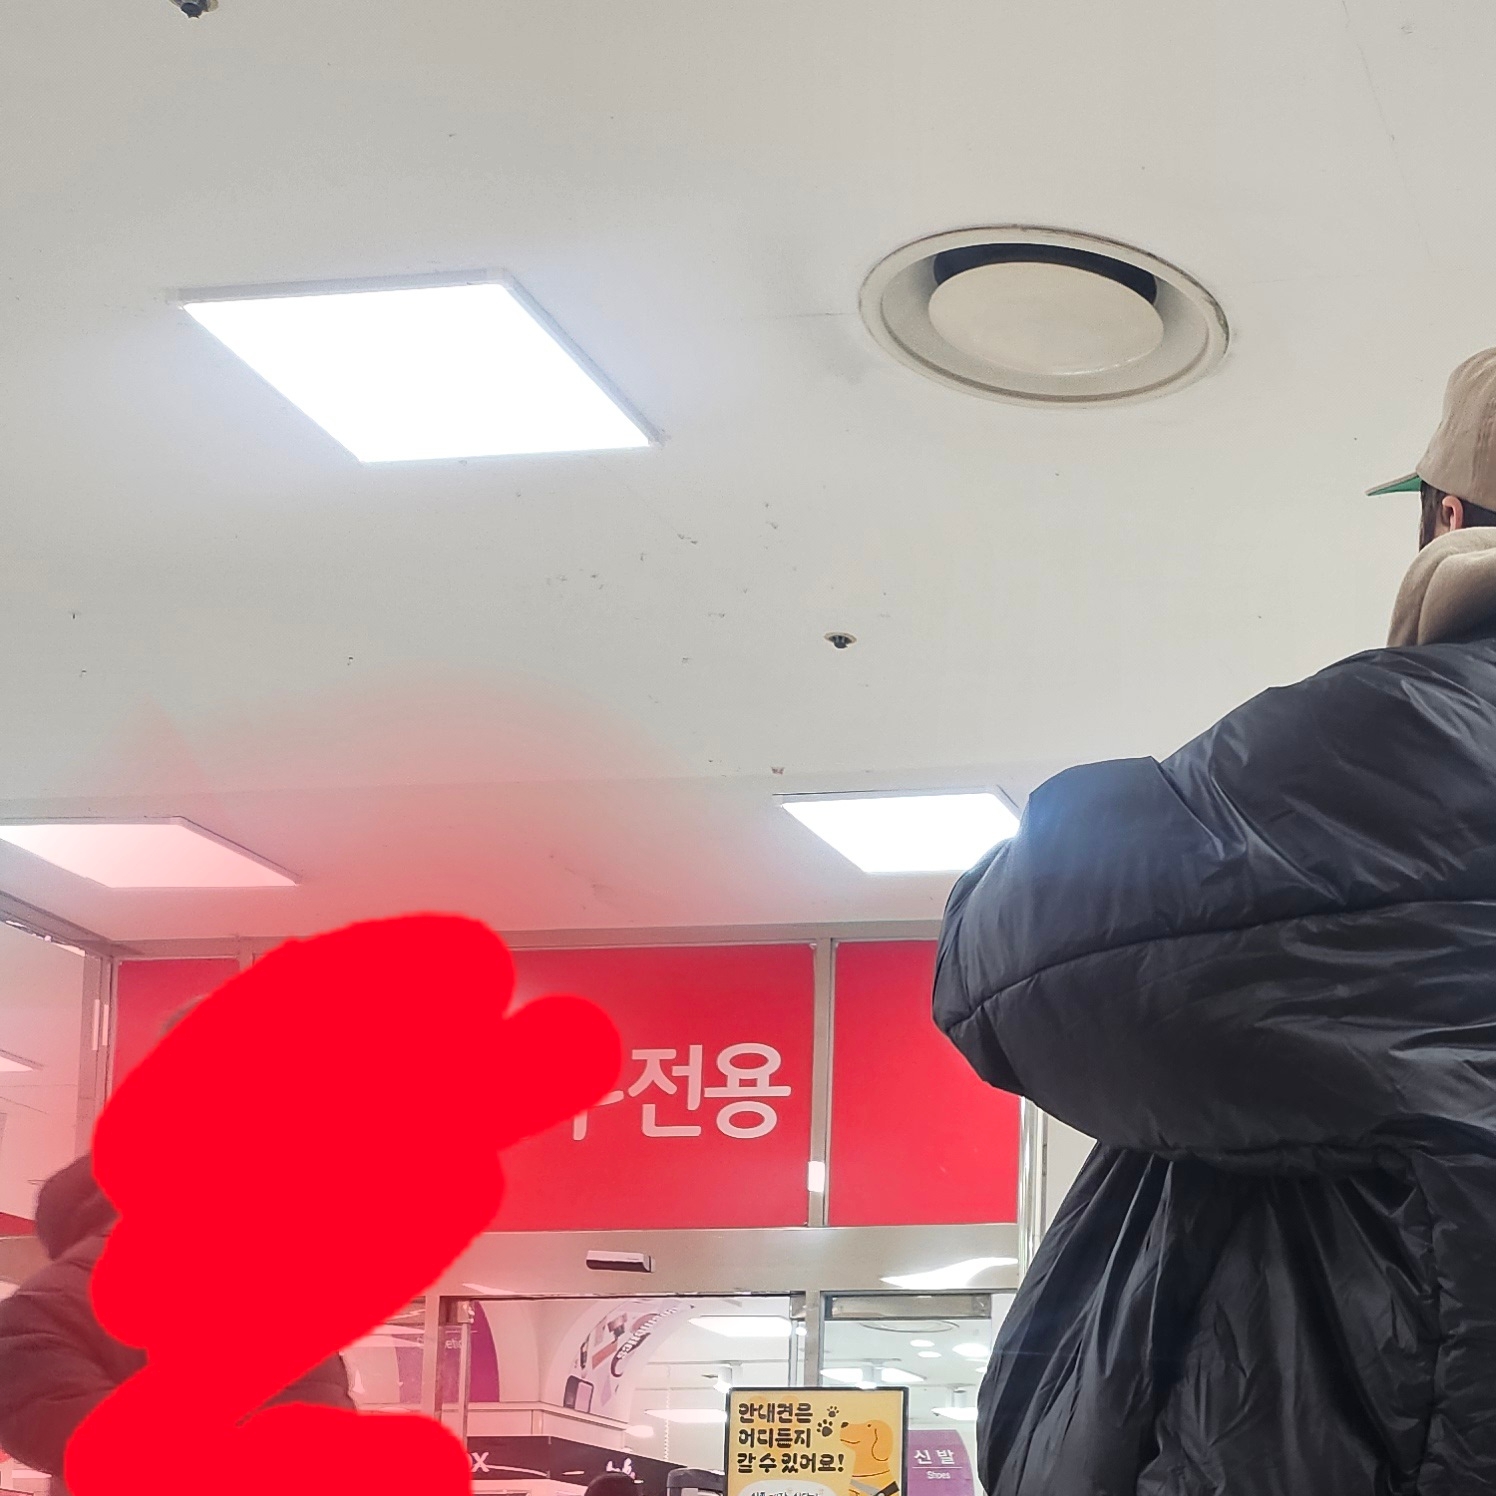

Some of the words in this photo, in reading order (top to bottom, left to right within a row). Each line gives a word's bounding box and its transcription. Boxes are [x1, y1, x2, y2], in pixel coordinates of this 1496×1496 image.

[738, 1402, 813, 1424] 안내견은
[738, 1428, 811, 1448] 어디든지
[737, 1453, 756, 1473] 갈
[759, 1453, 777, 1473] 수
[781, 1453, 845, 1473] 있어요!
[926, 1471, 951, 1480] Shoes
